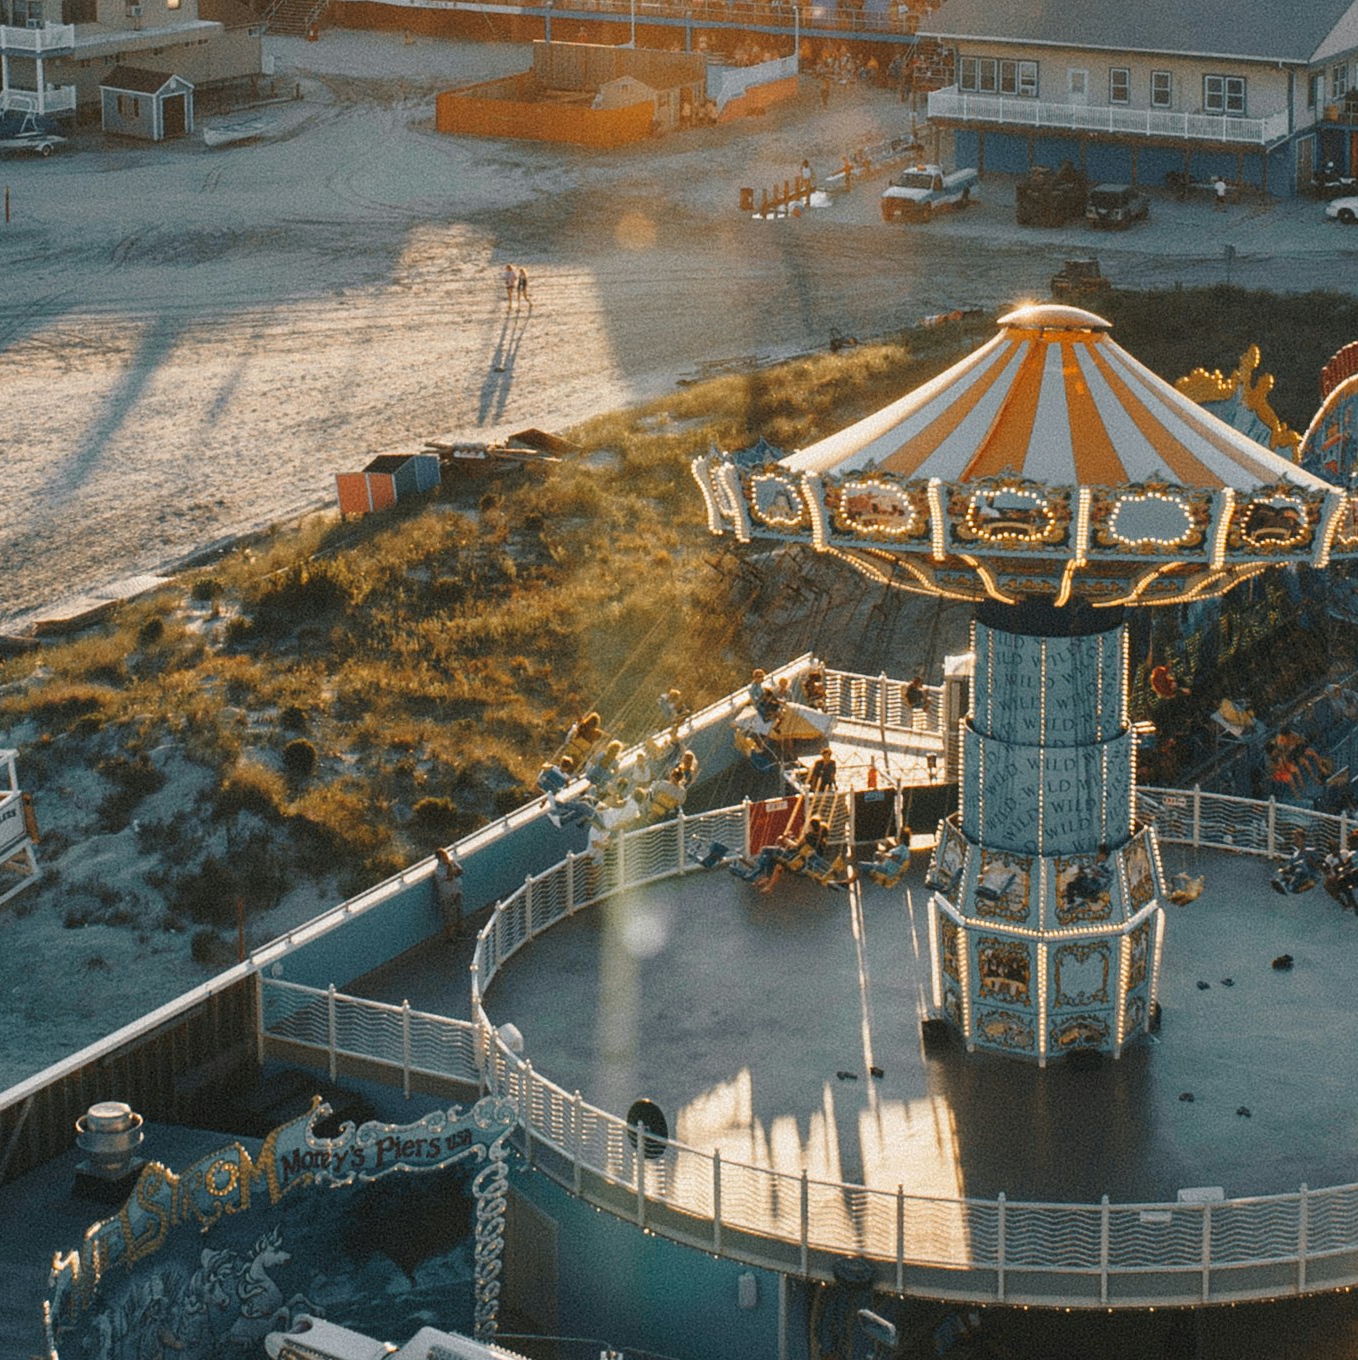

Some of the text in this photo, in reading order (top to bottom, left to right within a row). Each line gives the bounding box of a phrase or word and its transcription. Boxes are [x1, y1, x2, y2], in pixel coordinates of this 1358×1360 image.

[1021, 780, 1071, 798] WLD
[280, 1128, 473, 1184] Morey's Piers USA
